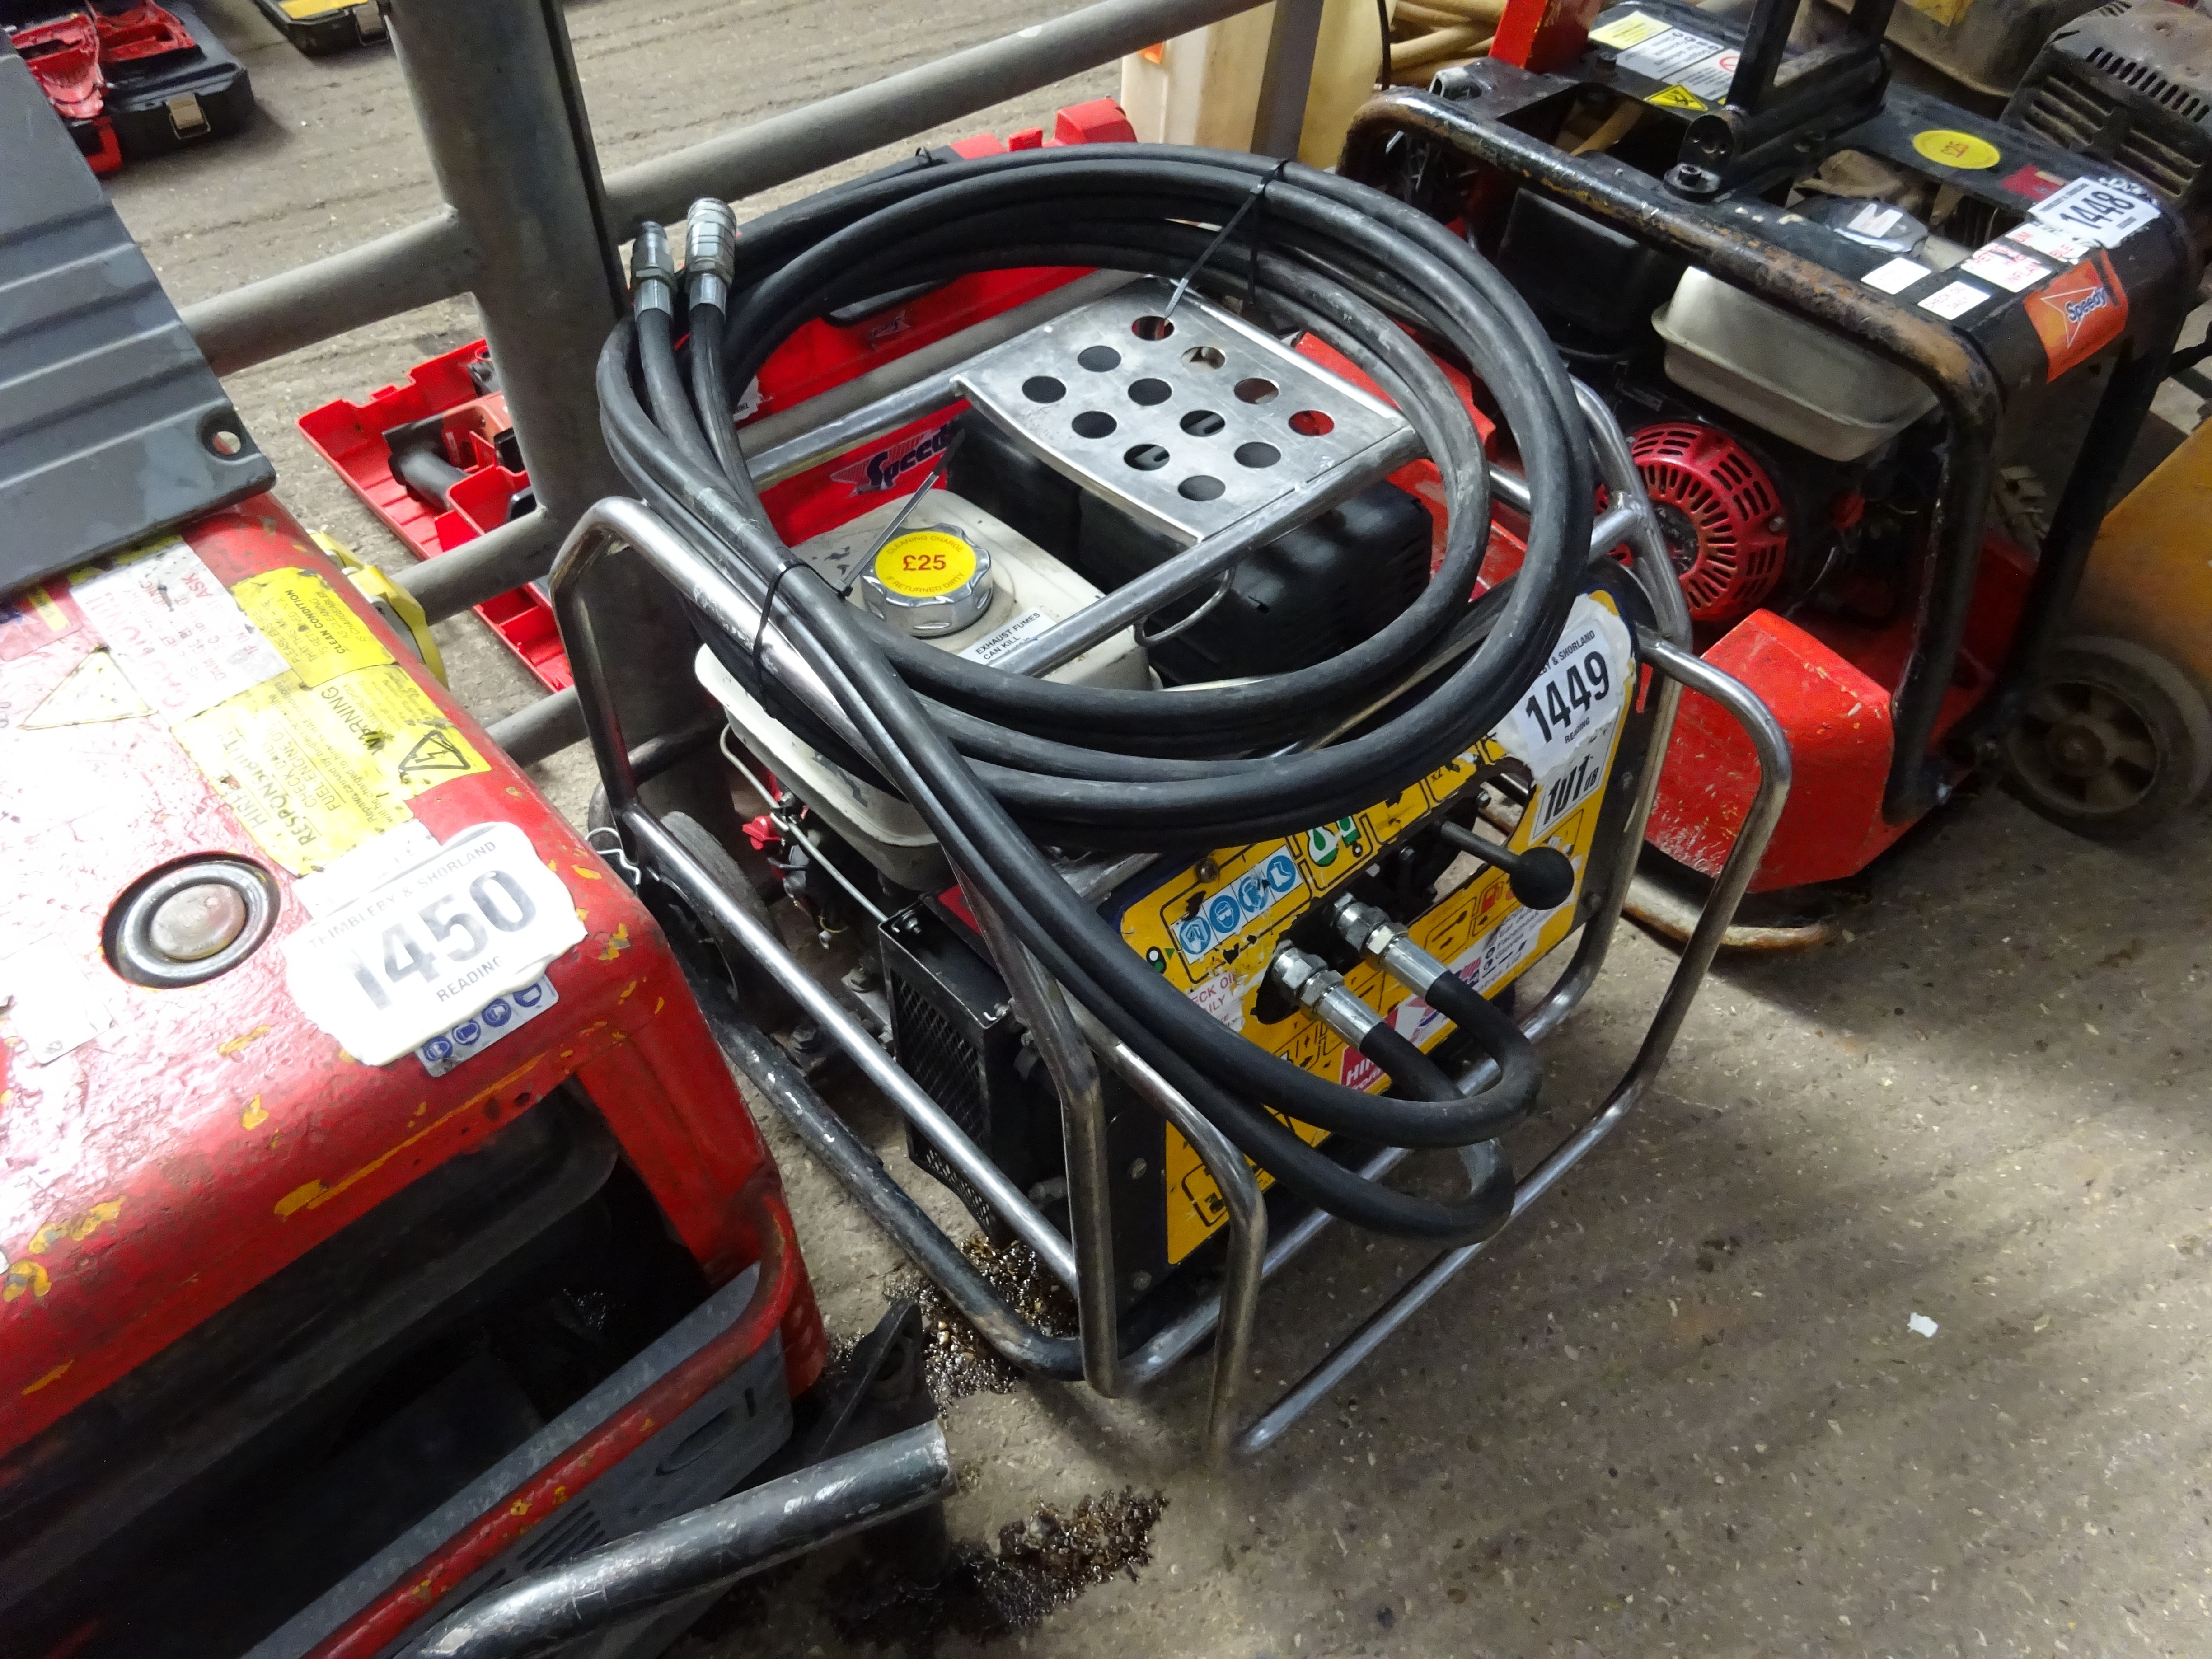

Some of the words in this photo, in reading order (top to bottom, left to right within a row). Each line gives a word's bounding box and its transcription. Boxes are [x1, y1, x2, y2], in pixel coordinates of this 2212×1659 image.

[2059, 191, 2136, 229] 1448
[2064, 286, 2107, 323] Speedy
[867, 422, 950, 488] Speed
[886, 535, 928, 554] CLEANING
[930, 535, 964, 553] CHARGE
[903, 554, 947, 571] £25
[180, 572, 214, 599] ASK
[893, 580, 942, 593] RETURNED
[943, 572, 965, 588] DIRTY
[284, 589, 324, 629] CONDITION
[309, 597, 342, 630] CLEANING
[286, 629, 303, 645] THIS
[288, 610, 322, 646] RETUNED
[319, 629, 346, 654] CLEAN
[337, 629, 350, 638] AS
[975, 629, 1012, 655] EXHAUST
[1012, 612, 1040, 632] FUMES
[274, 636, 302, 664] PLEASE
[298, 646, 318, 662] THAT
[983, 647, 1002, 660] CAN
[1002, 636, 1021, 649] KILL
[1551, 656, 1559, 665] &
[1559, 630, 1595, 661] SHORLAND
[1526, 651, 1610, 744] 1449
[1565, 717, 1590, 744] READING
[279, 741, 317, 781] ENGINE
[319, 756, 335, 767] by
[337, 760, 349, 769] to
[281, 769, 318, 809] CHECK
[326, 766, 354, 794] caused
[343, 769, 374, 799] charged
[311, 782, 342, 811] FUEL
[368, 797, 383, 809] be
[401, 885, 414, 898] &
[417, 840, 497, 890] SHORLAND
[342, 870, 537, 1011] 1450
[436, 956, 504, 1002] READING
[1191, 984, 1217, 1005] ECK
